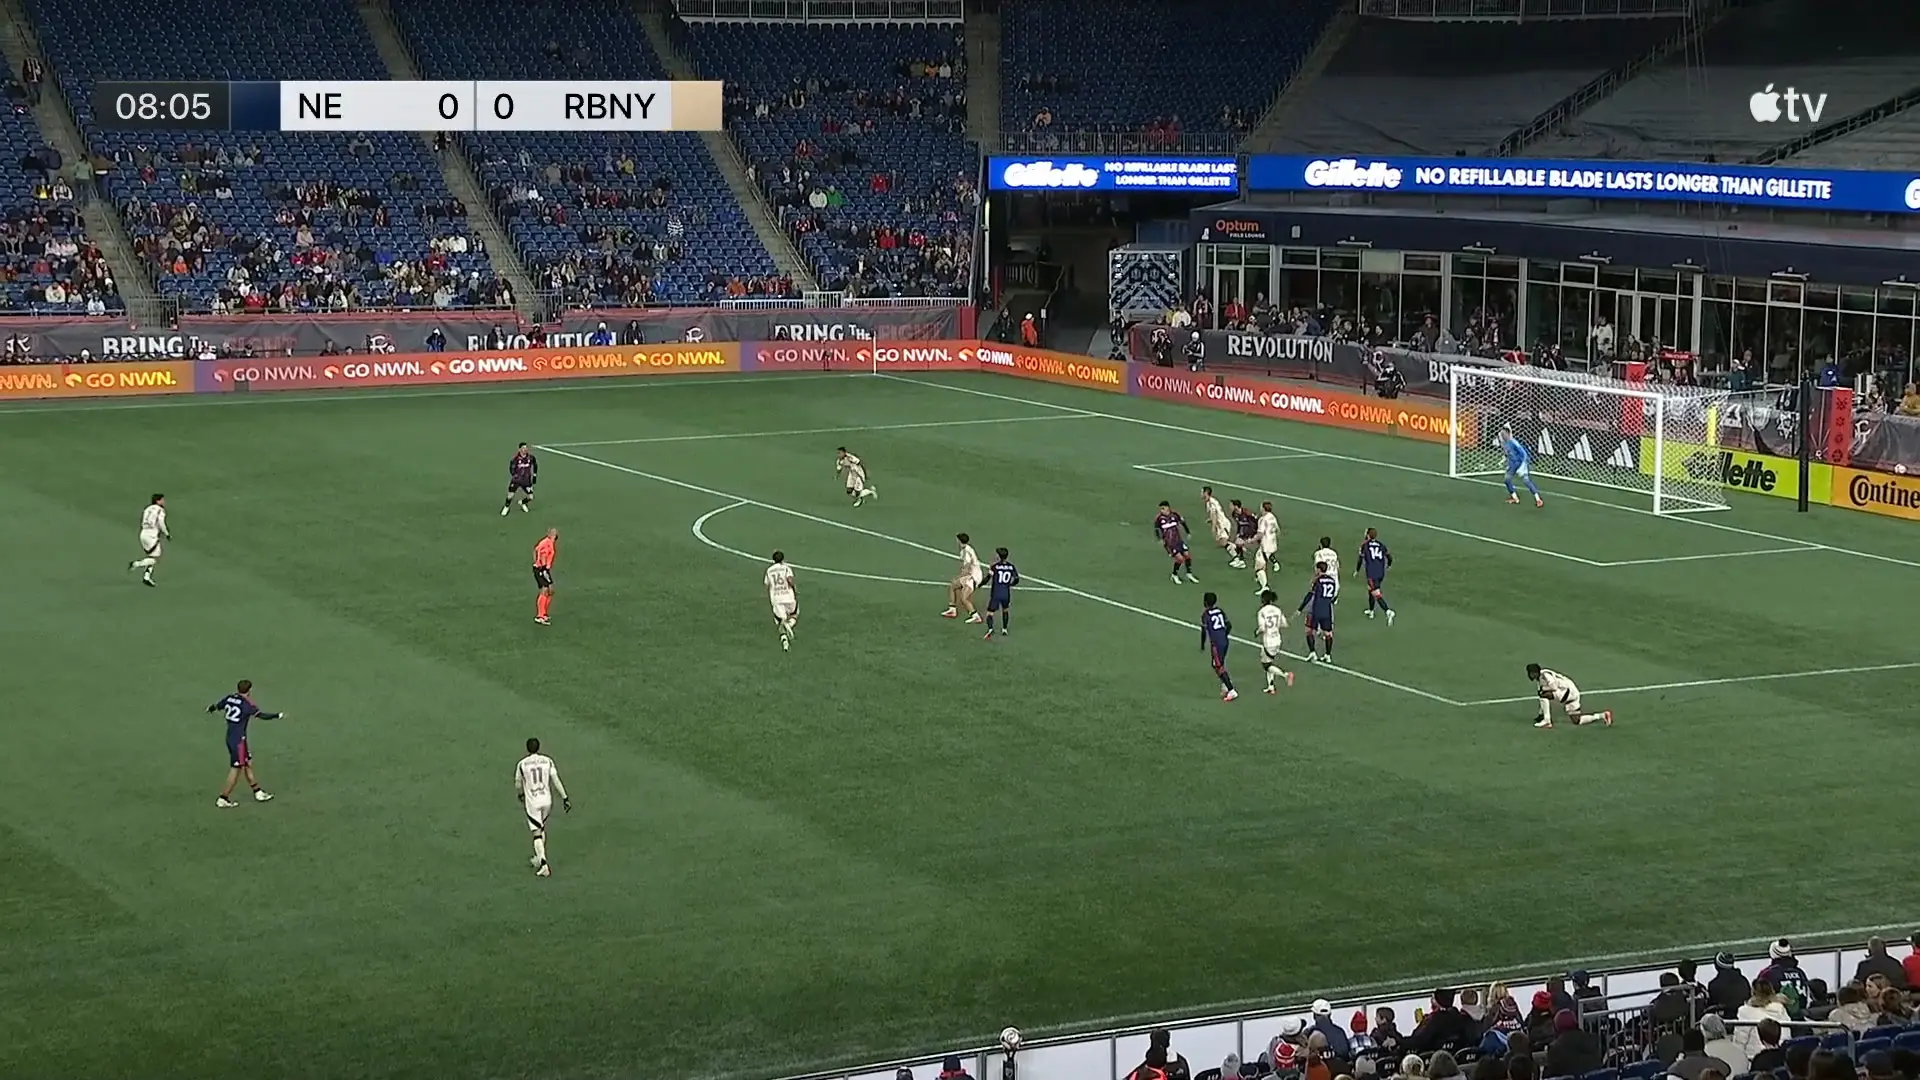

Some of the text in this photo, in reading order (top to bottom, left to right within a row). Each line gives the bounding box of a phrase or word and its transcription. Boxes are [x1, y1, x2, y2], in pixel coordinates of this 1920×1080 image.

[1003, 161, 1098, 188] Gillette
[1104, 162, 1124, 172] NO
[1124, 162, 1178, 173] REFILLABLE
[1178, 163, 1210, 173] BLADE
[1115, 175, 1231, 186] LONGER THAN GILLETTE
[1304, 159, 1831, 199] Gillette NO REFILLABLE BLADE LASTS LONGER THAN GILLETTE
[1215, 219, 1259, 234] Optum
[103, 336, 184, 357] BRING
[1228, 334, 1334, 363] REVOLUTION
[551, 353, 627, 370] GO NWN.
[650, 351, 725, 366] GO NWN.
[774, 349, 798, 362] GO
[876, 349, 952, 362] GO NWN.
[976, 349, 1014, 366] GO NWN.
[233, 366, 317, 382] GO NWN.
[343, 362, 424, 378] GO NWN.
[449, 357, 528, 374] GO NWN.
[1024, 356, 1065, 375] GO NWN.
[0, 373, 57, 389] NWN.
[86, 371, 177, 388] GO NWN.
[1076, 365, 1119, 385] GO NWN.
[1147, 376, 1193, 395] GO NWN.
[1206, 383, 1256, 405] GO NWN.
[1271, 391, 1324, 414] GO NWN.
[1340, 402, 1394, 425] GO NWN.
[1409, 414, 1427, 430] GO
[1369, 546, 1383, 560] 14
[772, 573, 785, 586] 16
[997, 570, 1012, 584] 10
[1322, 583, 1334, 598] 12
[1211, 613, 1226, 630] 21
[224, 704, 242, 723] 22
[530, 766, 543, 785] 11
